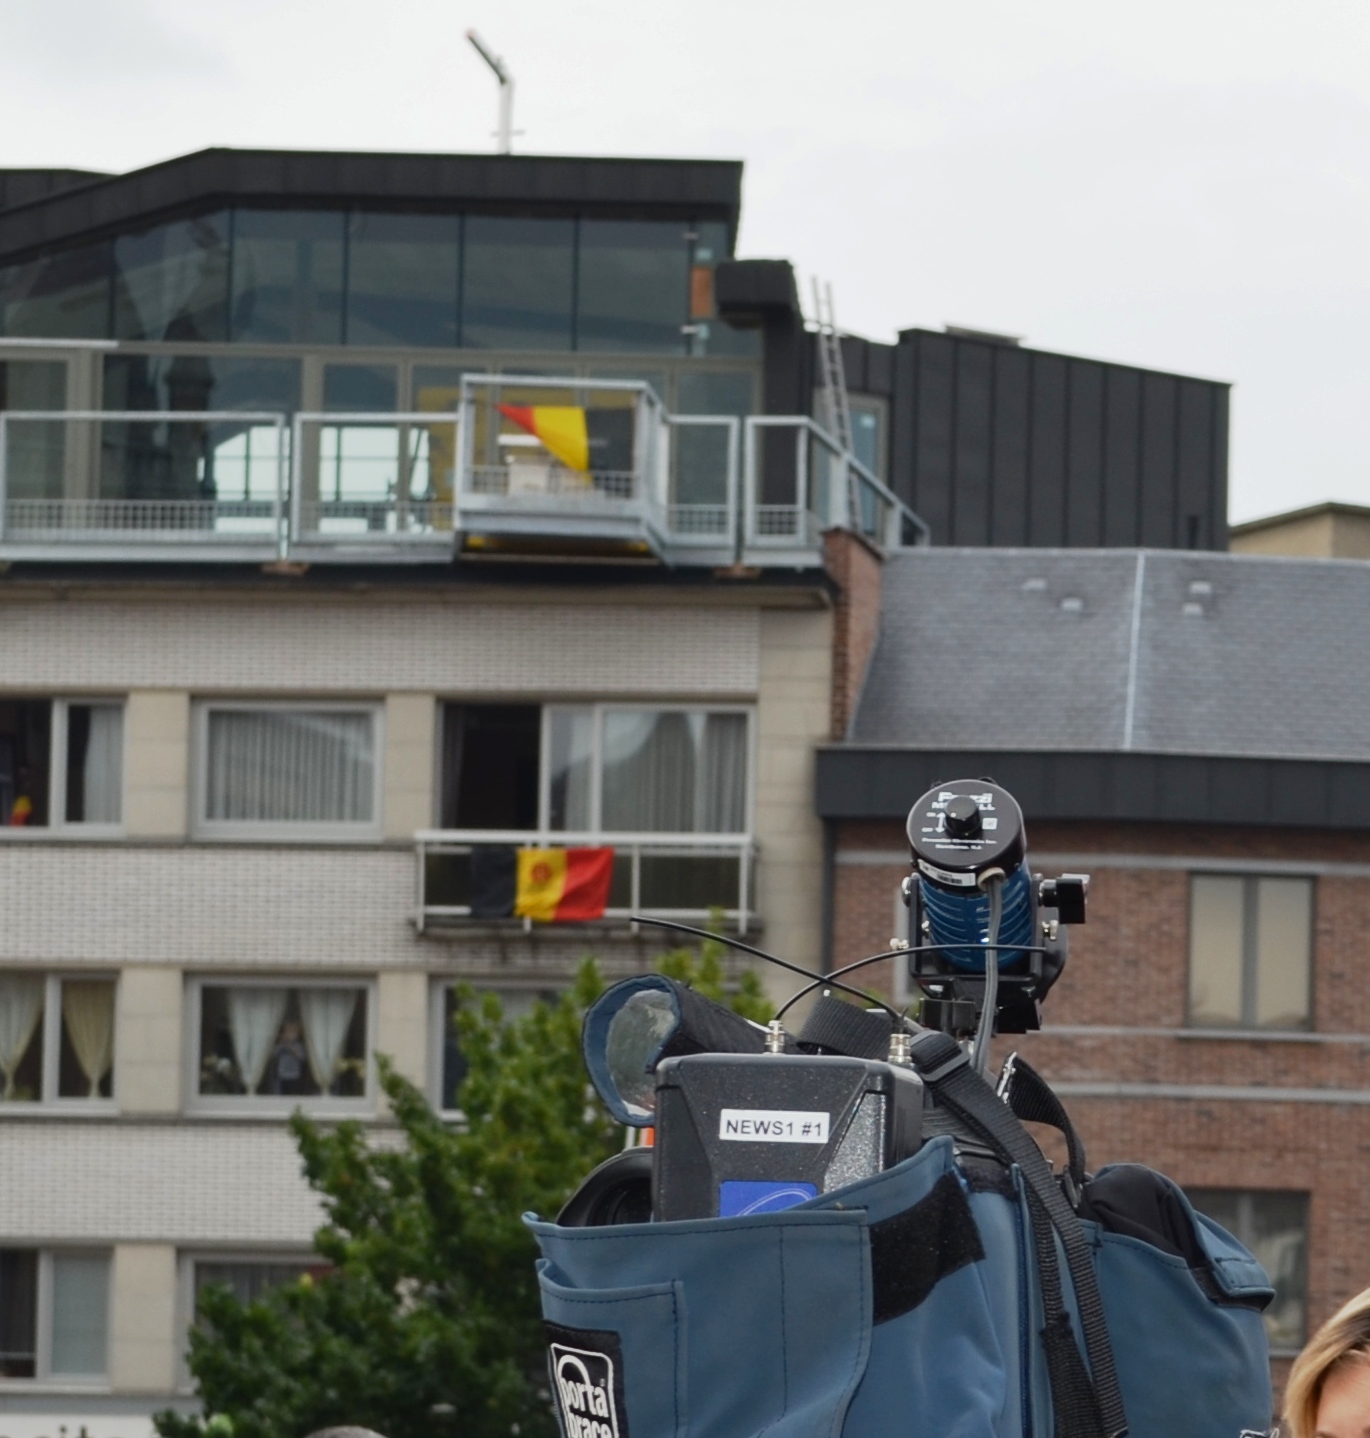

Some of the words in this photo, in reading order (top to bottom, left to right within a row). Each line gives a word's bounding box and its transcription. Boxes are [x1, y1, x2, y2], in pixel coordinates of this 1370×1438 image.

[726, 1119, 793, 1136] NEWS1
[802, 1121, 823, 1137] #1
[559, 1377, 610, 1418] porta
